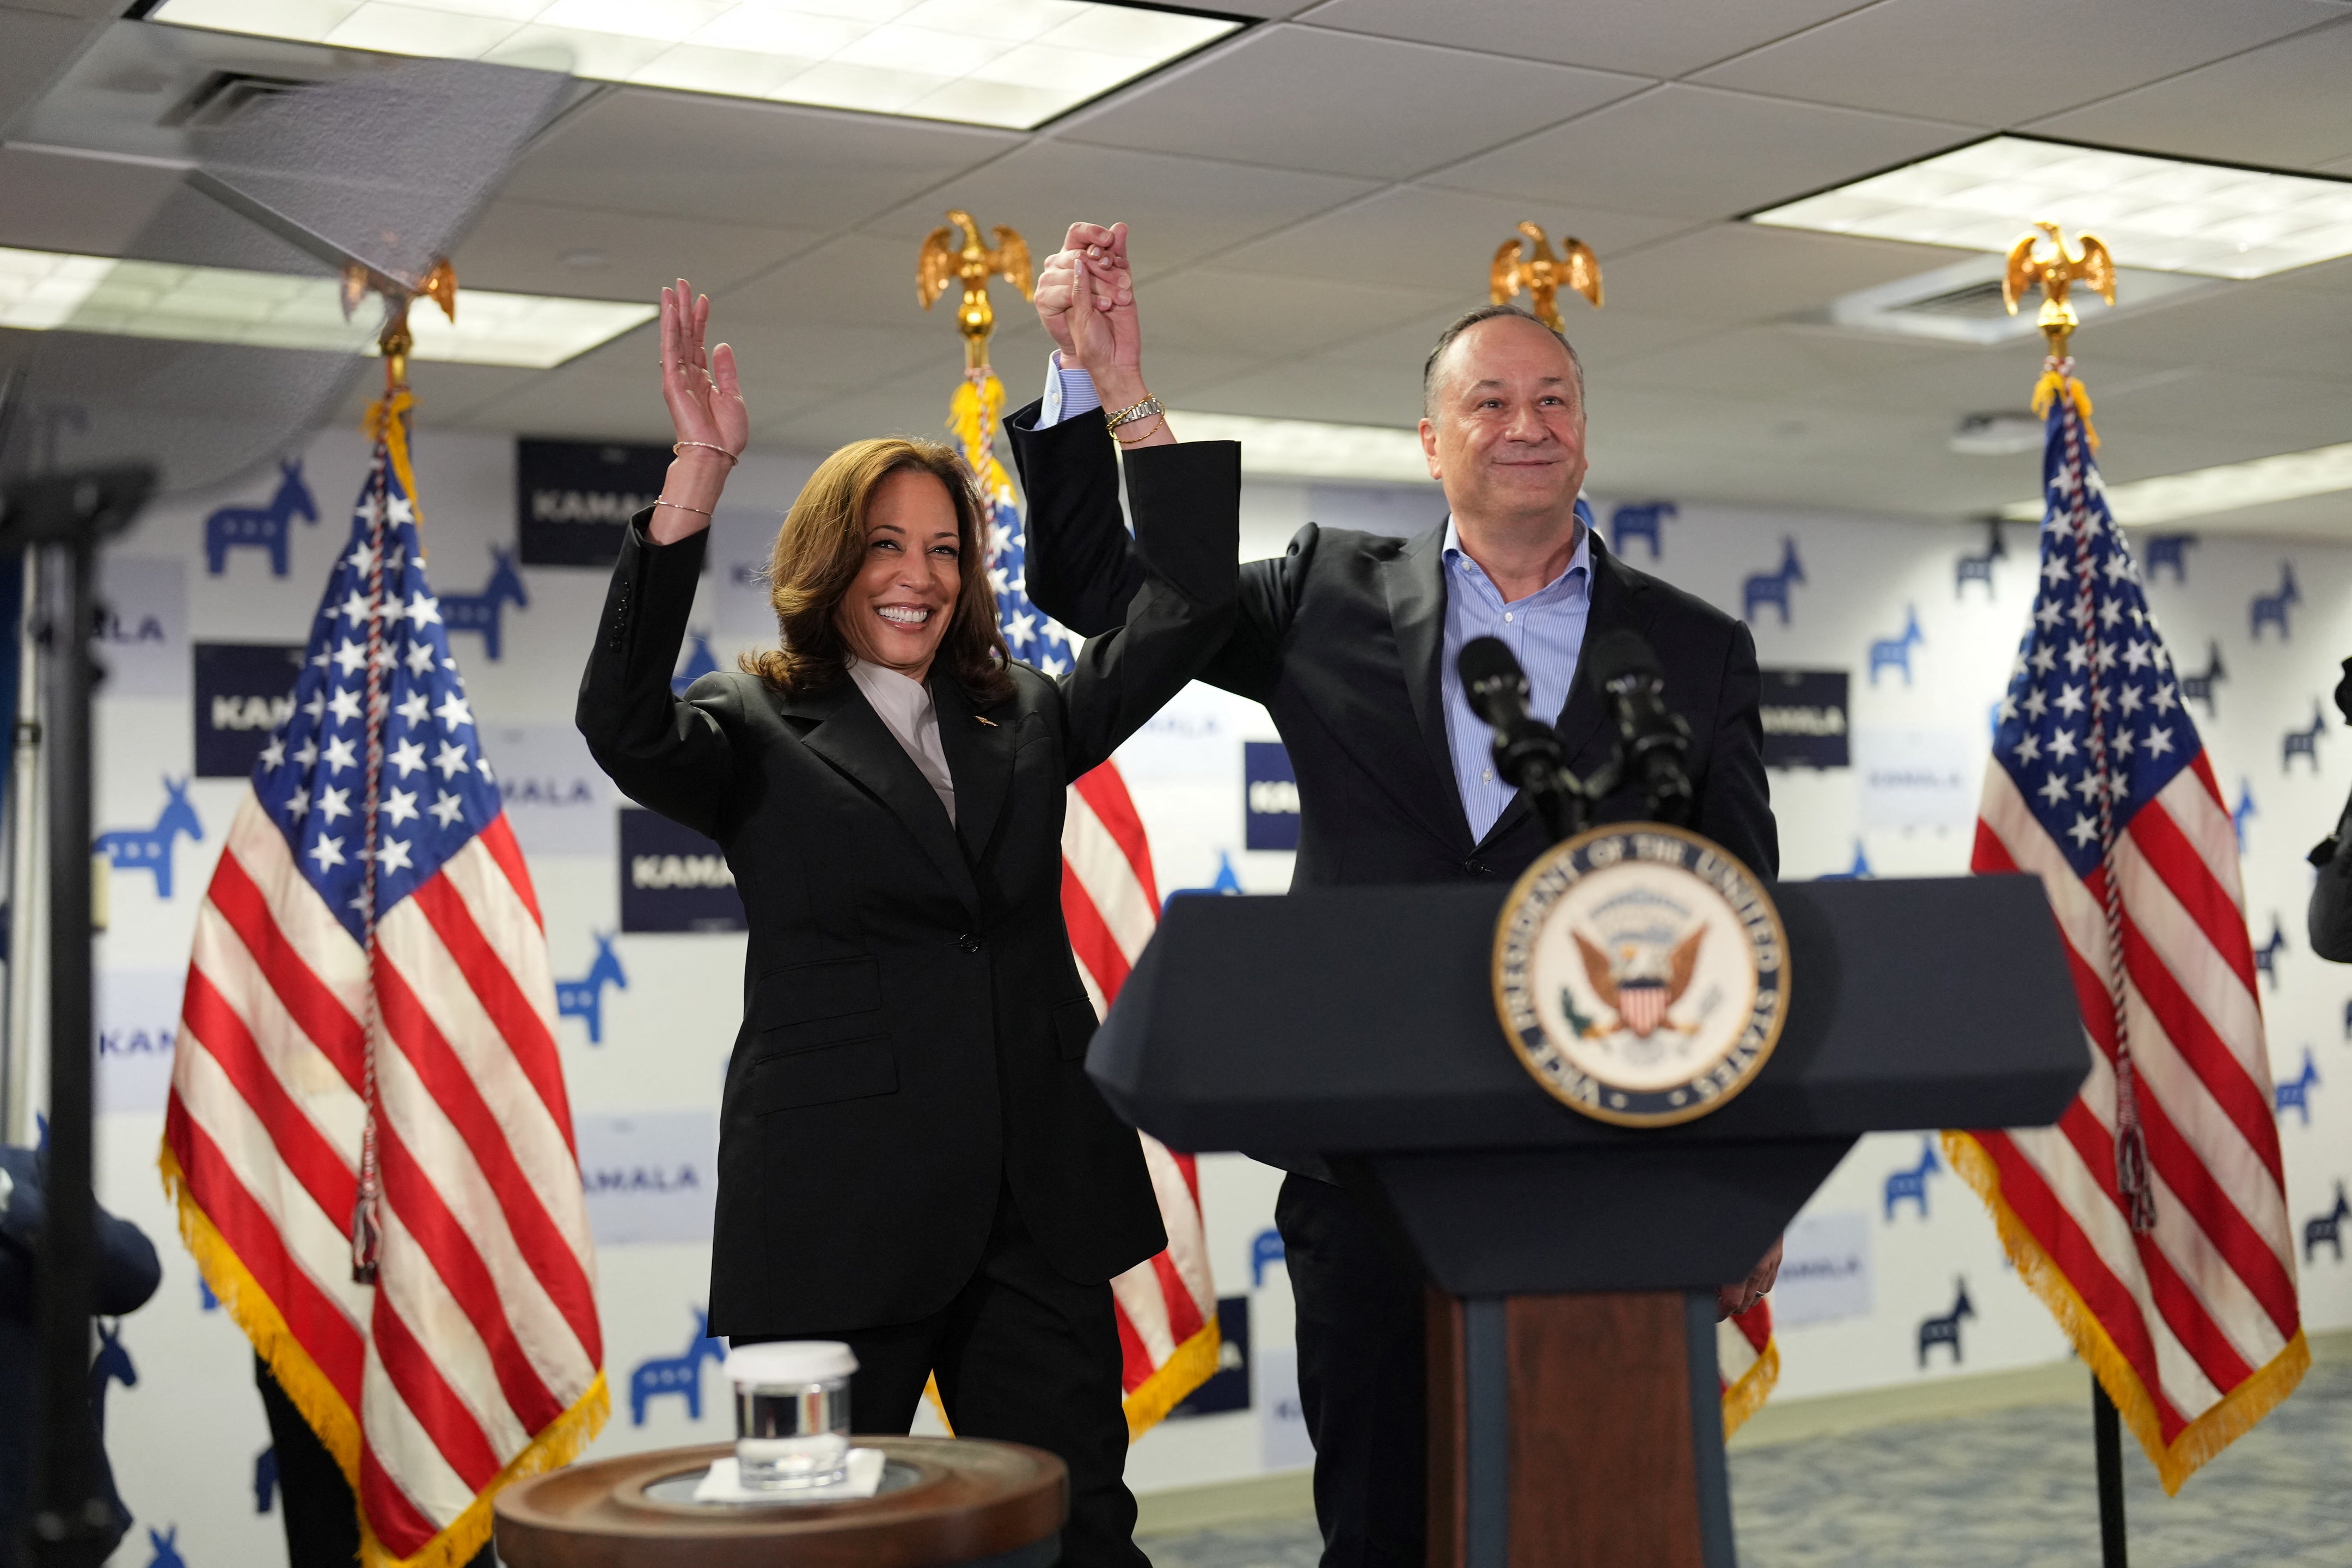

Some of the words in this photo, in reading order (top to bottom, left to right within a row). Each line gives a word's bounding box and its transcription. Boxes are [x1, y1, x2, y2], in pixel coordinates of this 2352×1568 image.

[1586, 835, 1625, 869] OF
[1693, 848, 1782, 973] UNITED
[1692, 988, 1780, 1104] STATES
